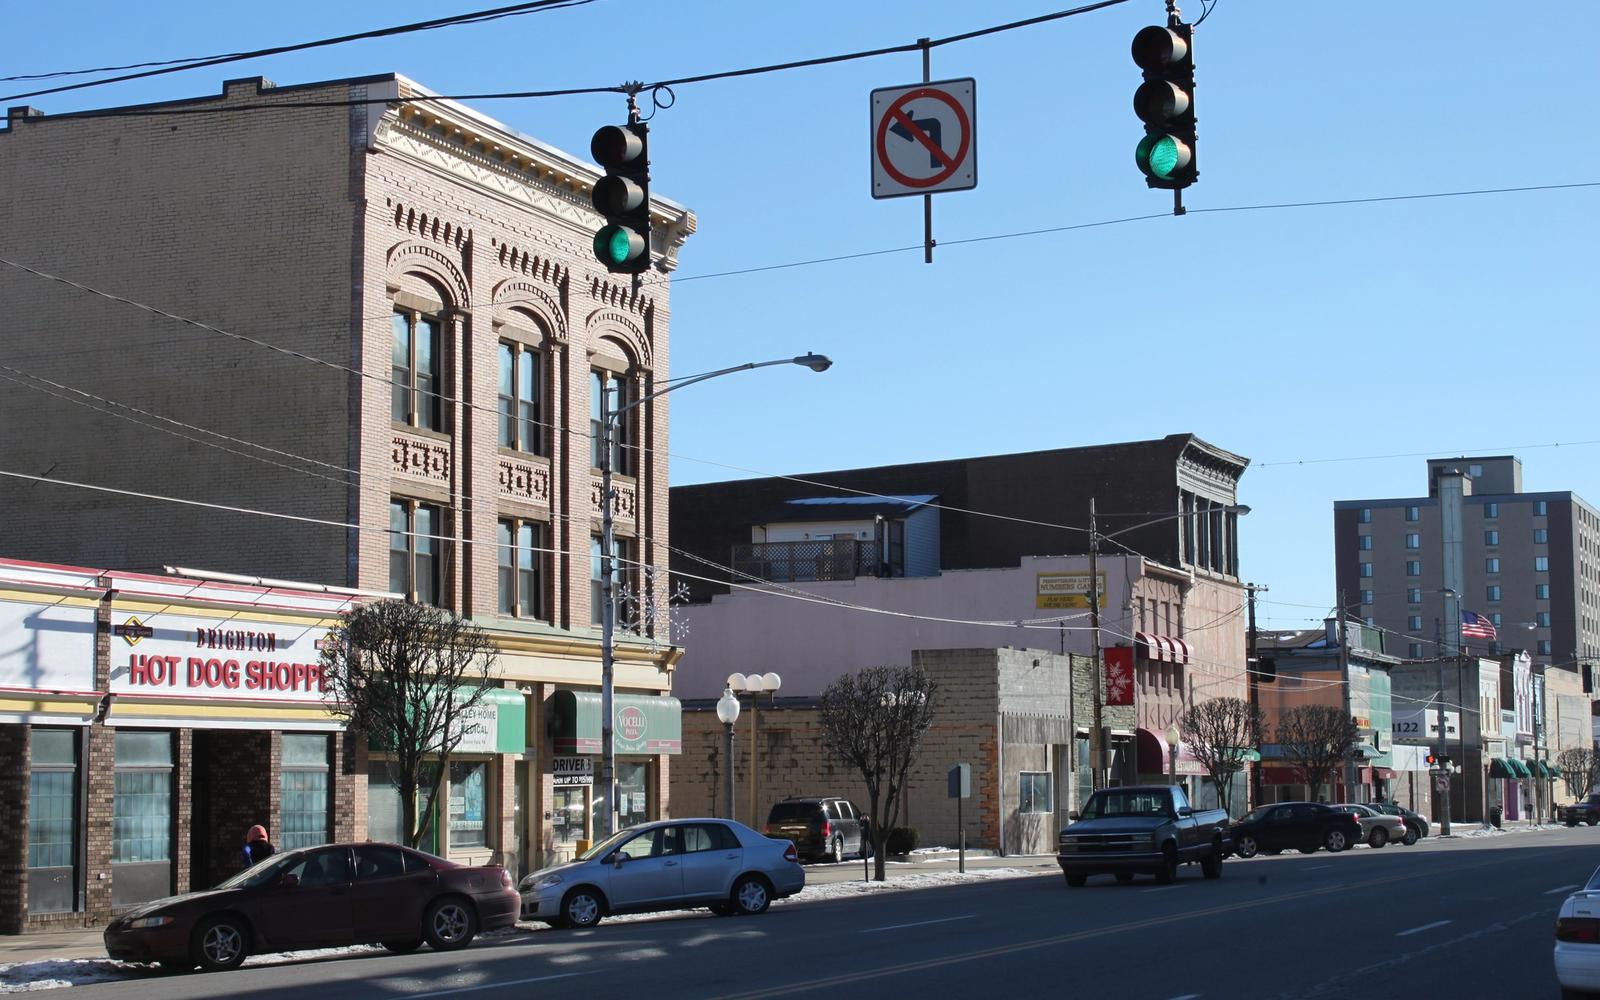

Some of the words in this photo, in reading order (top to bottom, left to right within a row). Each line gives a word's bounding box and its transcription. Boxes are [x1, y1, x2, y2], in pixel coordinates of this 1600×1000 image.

[1040, 583, 1075, 591] NUMBERS
[197, 627, 276, 652] BRIGHTON
[129, 654, 181, 686] HOT
[187, 656, 240, 688] DOG
[245, 659, 329, 692] SHOPPE
[478, 710, 496, 719] HOME
[618, 714, 645, 728] VOCELLI
[1392, 722, 1419, 733] 1122
[564, 776, 572, 784] UP
[572, 775, 579, 784] TO
